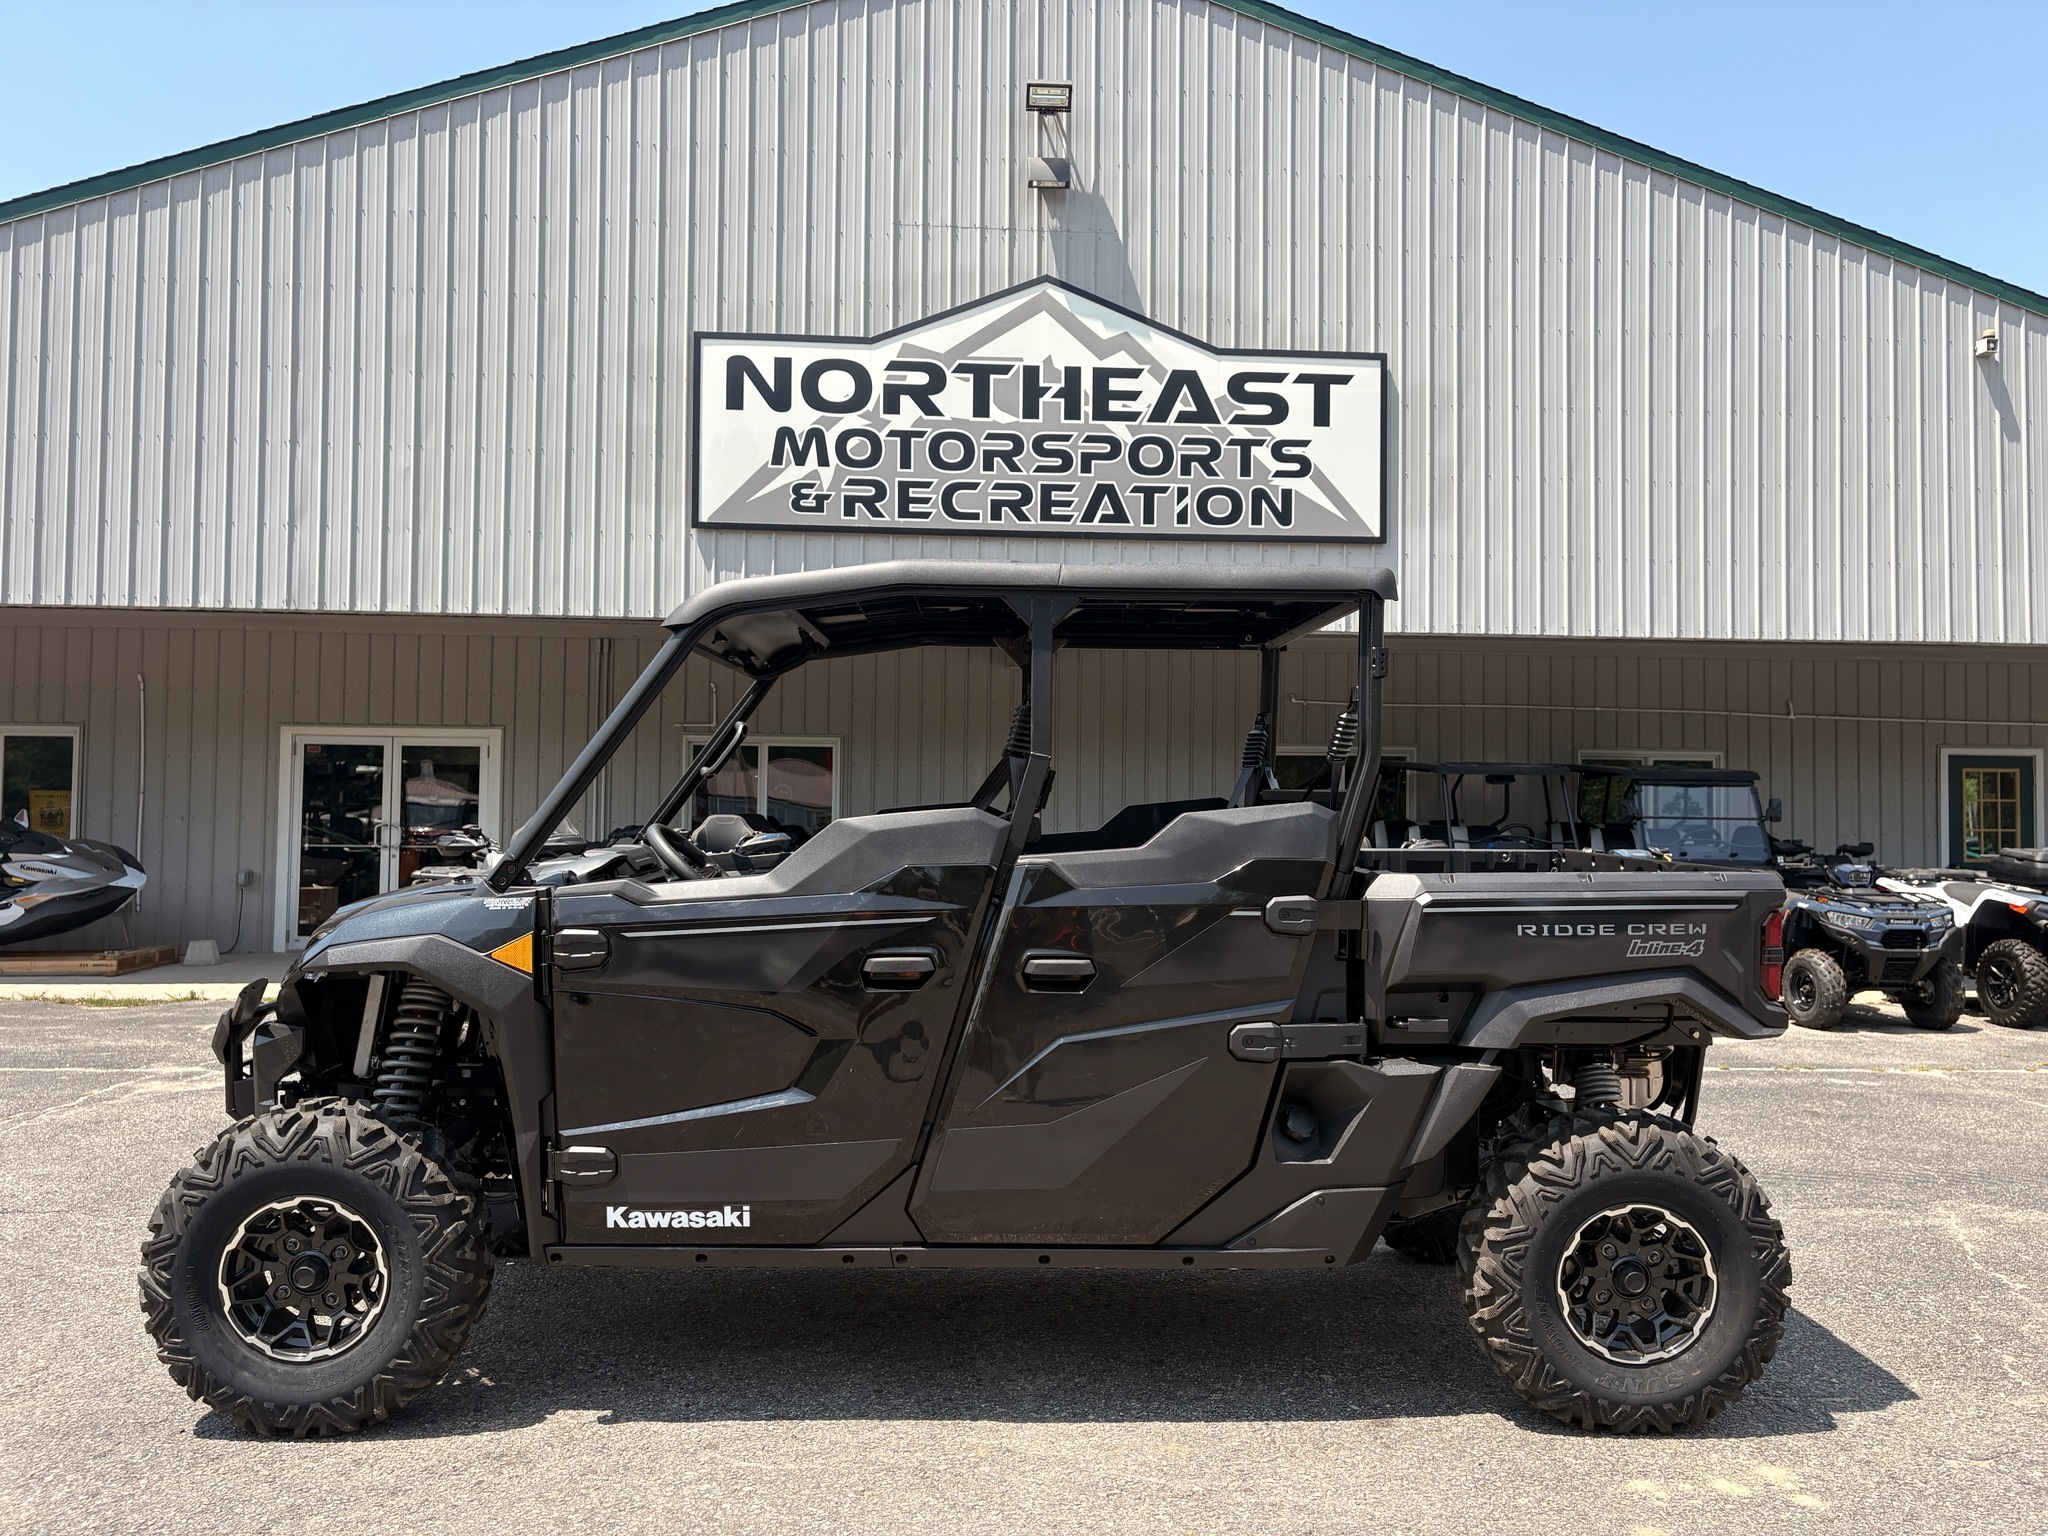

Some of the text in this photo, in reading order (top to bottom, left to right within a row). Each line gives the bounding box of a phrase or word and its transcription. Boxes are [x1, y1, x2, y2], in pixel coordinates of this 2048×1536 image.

[726, 354, 1355, 427] NORTHEAST
[770, 426, 1312, 478] MOTORSPORTS
[19, 863, 58, 876] Kawasaki
[1517, 923, 1707, 937] RIDGE CREW
[1626, 938, 1706, 957] Inline-4
[606, 1205, 751, 1229] Kawasaki
